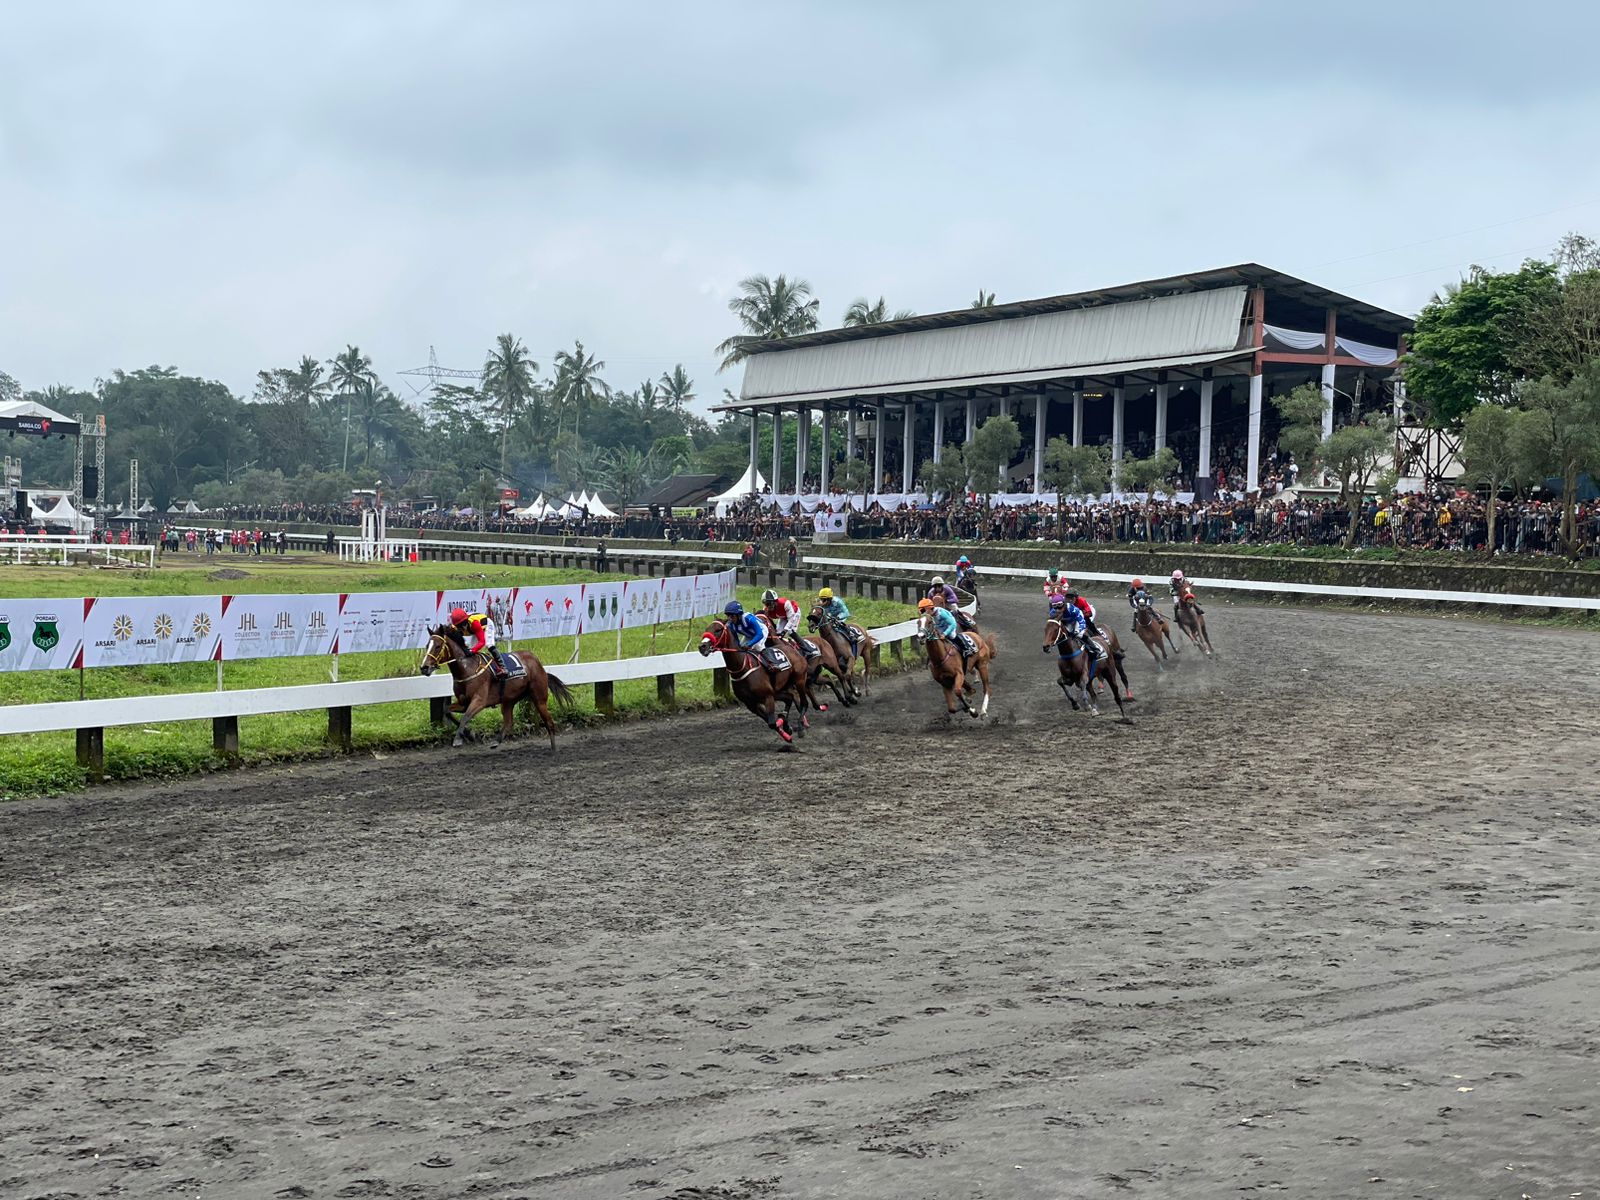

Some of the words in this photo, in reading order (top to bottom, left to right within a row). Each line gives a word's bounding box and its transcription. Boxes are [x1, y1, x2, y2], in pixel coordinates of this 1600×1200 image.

[238, 613, 258, 631] JHL
[273, 612, 293, 630] JHL
[308, 611, 326, 628] JHL
[774, 649, 786, 662] 4
